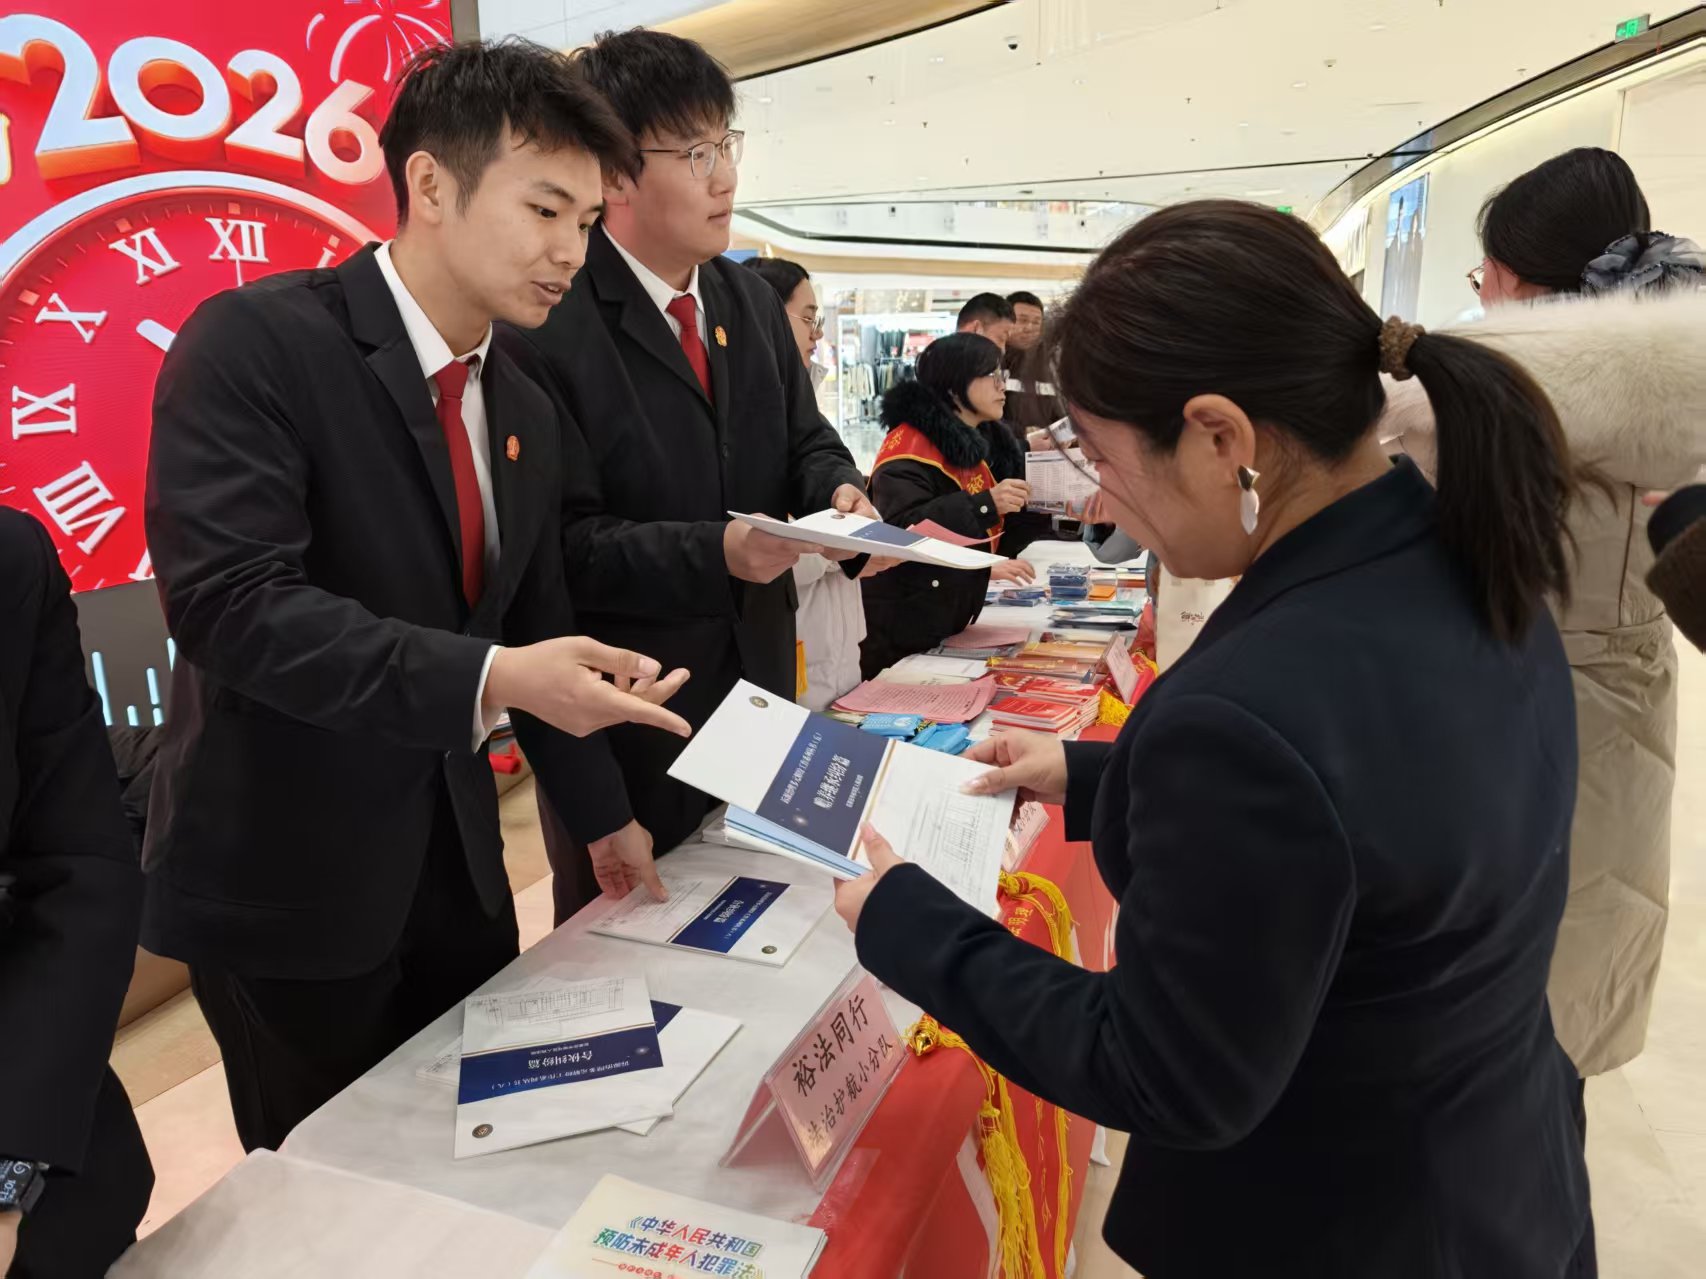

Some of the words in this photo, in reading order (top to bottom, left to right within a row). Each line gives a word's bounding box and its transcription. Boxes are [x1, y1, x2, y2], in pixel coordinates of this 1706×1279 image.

[0, 13, 384, 186] 2026
[109, 228, 181, 286] XI
[205, 217, 269, 263] XII
[36, 292, 108, 343] X
[12, 383, 77, 440] IX
[32, 460, 126, 555] VIII
[528, 1050, 593, 1069] 合伙纠纷篇
[792, 995, 869, 1097] 裕法同行
[807, 1034, 894, 1147] 法治护航小分队
[630, 1216, 763, 1258] 《中华人民共和国
